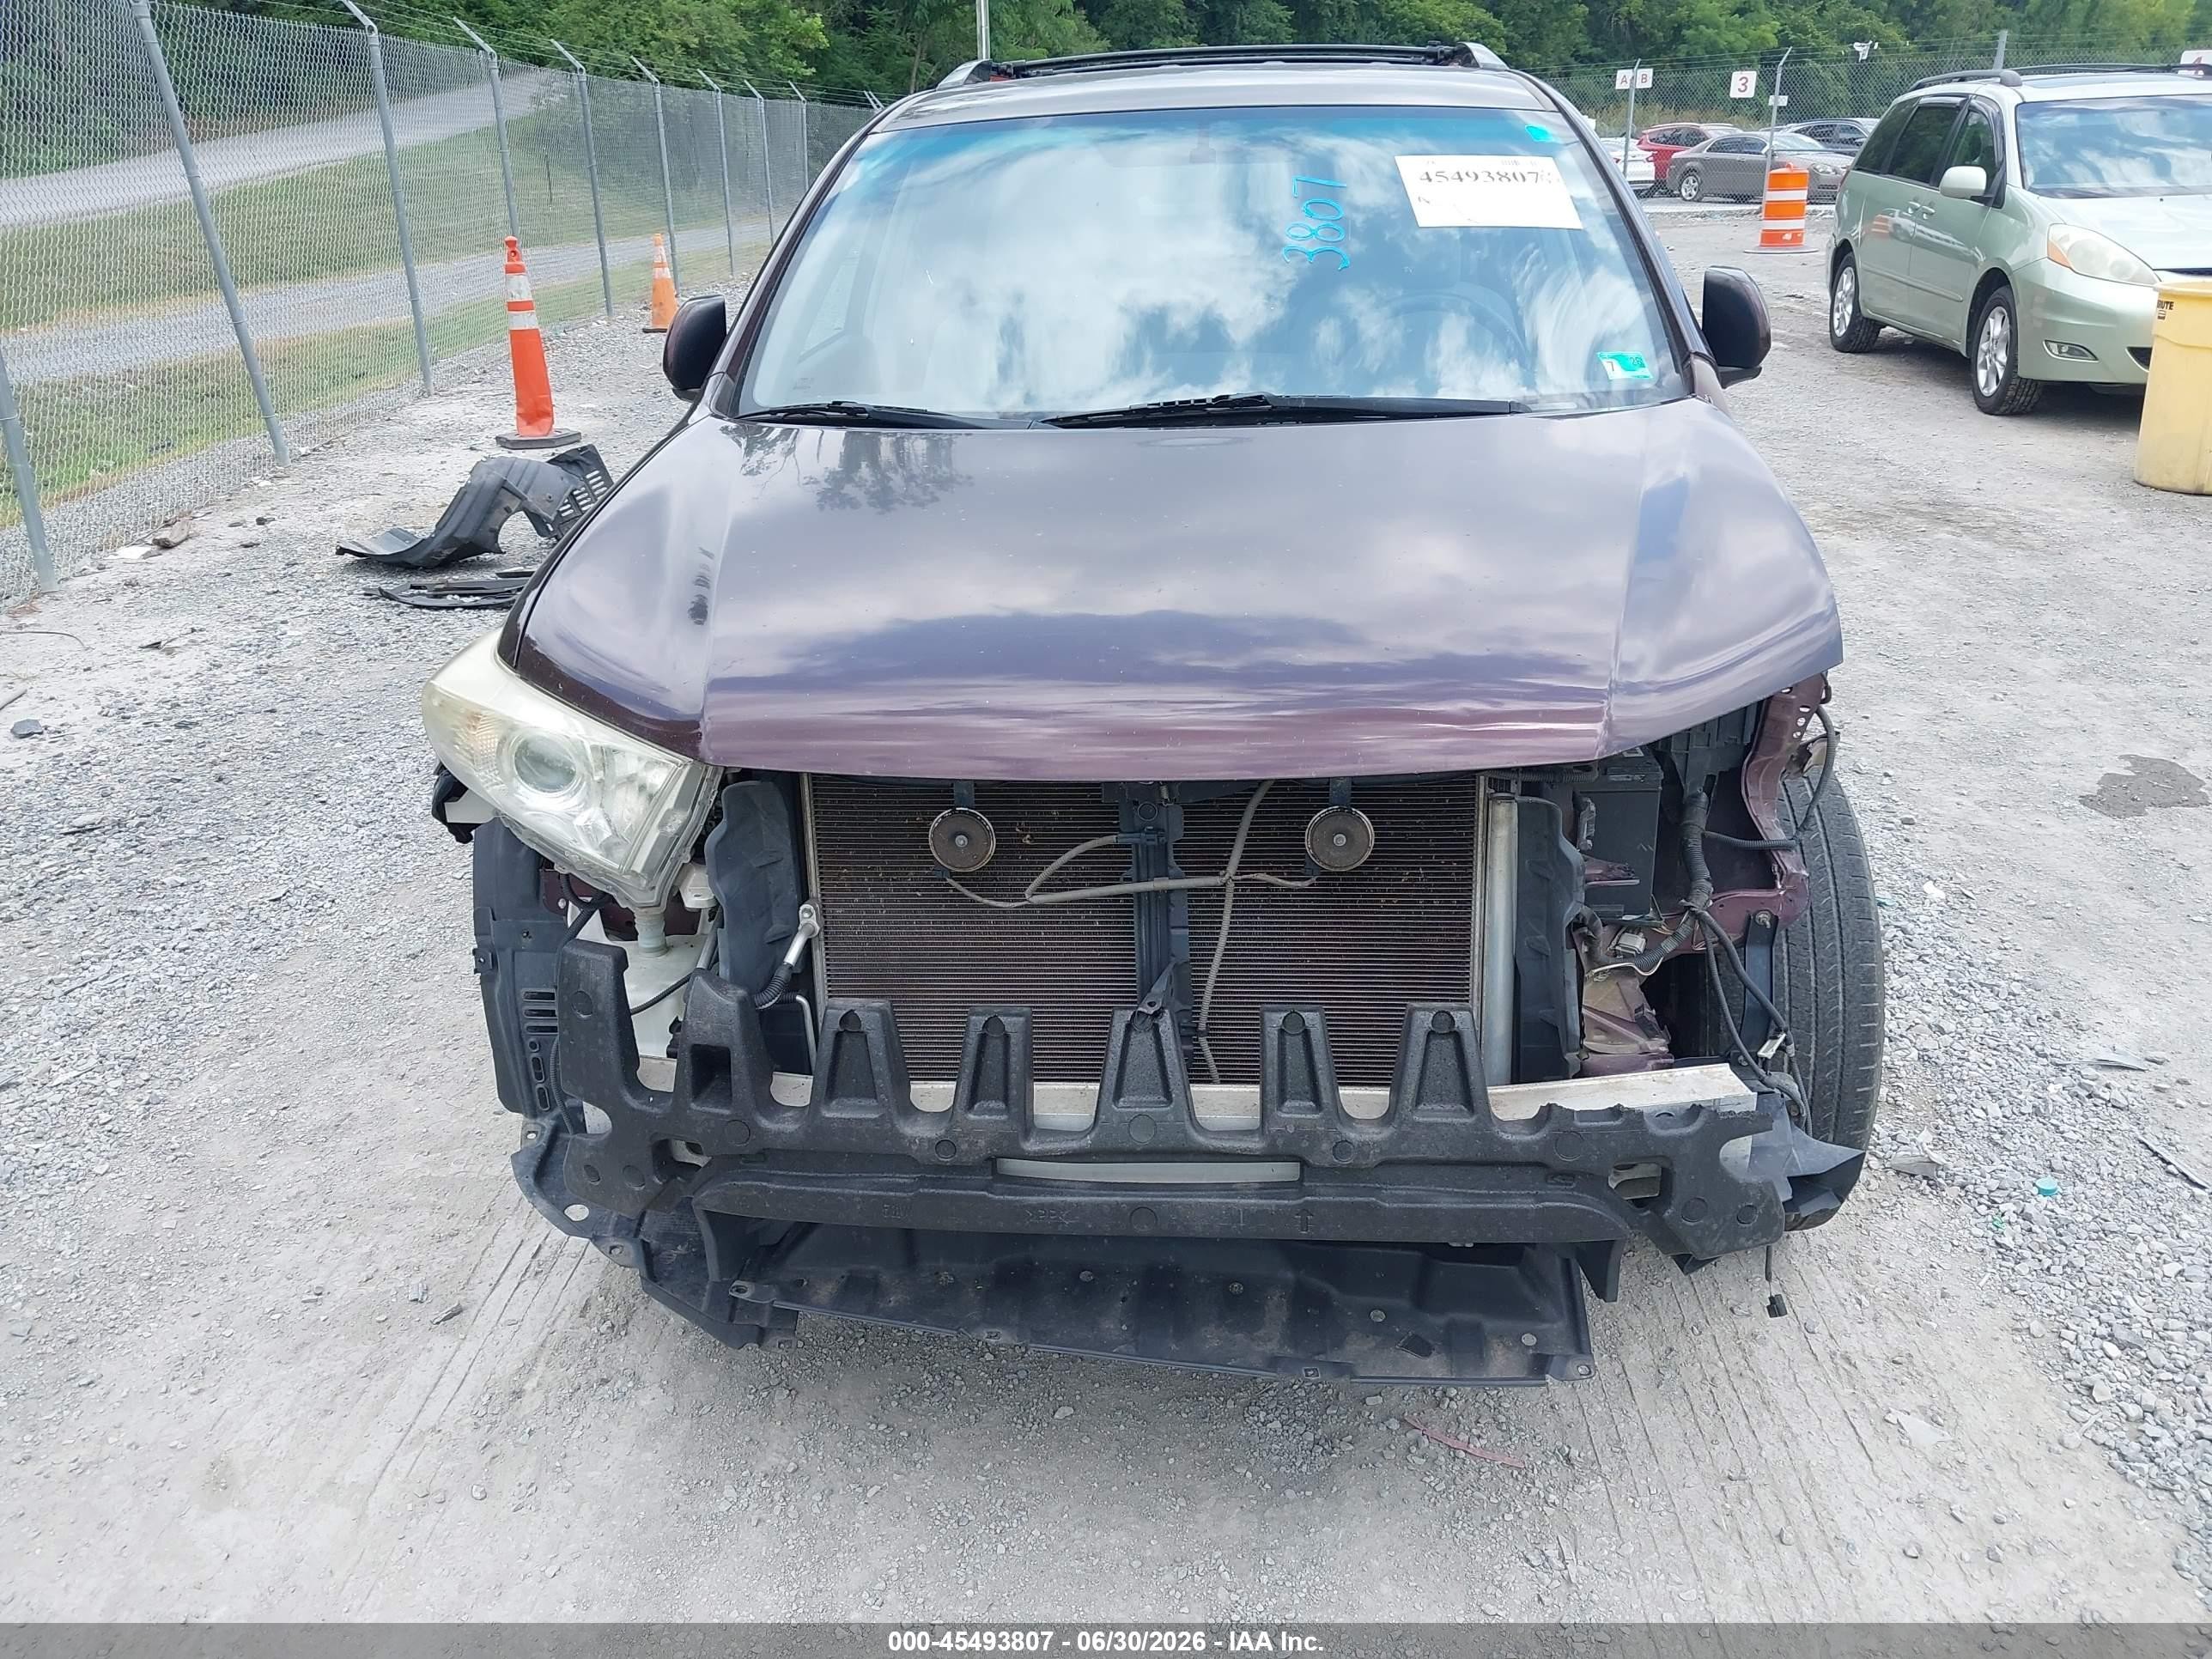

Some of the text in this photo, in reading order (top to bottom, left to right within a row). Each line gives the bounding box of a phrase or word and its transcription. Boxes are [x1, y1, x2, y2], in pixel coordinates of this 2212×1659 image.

[1620, 74, 1648, 84] A B
[1737, 76, 1749, 93] 3
[1419, 171, 1540, 184] 45493807
[1282, 175, 1351, 271] 3807
